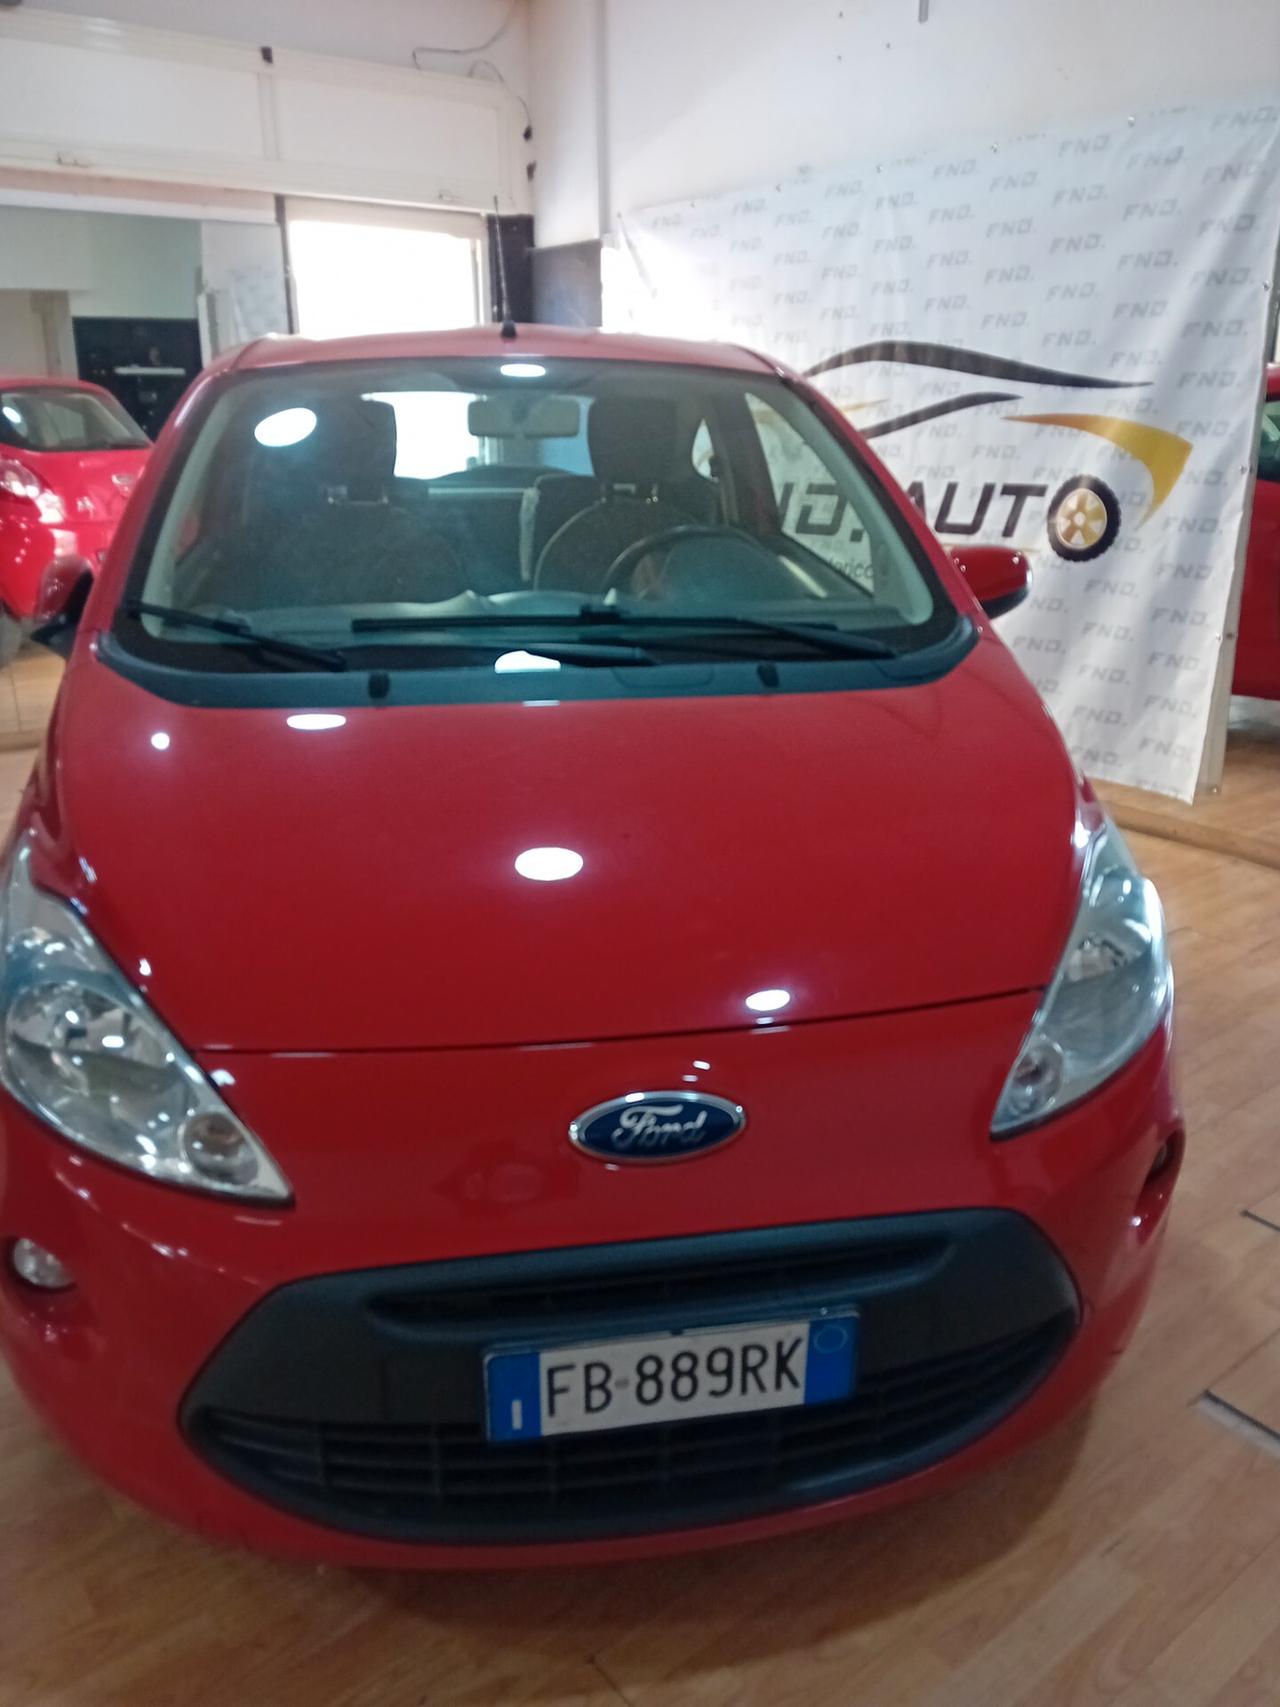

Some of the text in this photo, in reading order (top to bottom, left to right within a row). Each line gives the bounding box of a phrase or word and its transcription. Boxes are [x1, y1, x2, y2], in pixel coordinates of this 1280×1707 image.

[1116, 249, 1178, 271] FND.
[979, 311, 1031, 330] FND.
[1041, 328, 1096, 347] FND.
[1084, 578, 1139, 598] FND.
[1081, 621, 1134, 642] FND.
[1077, 664, 1130, 685] FND.
[612, 1104, 708, 1147] Ford
